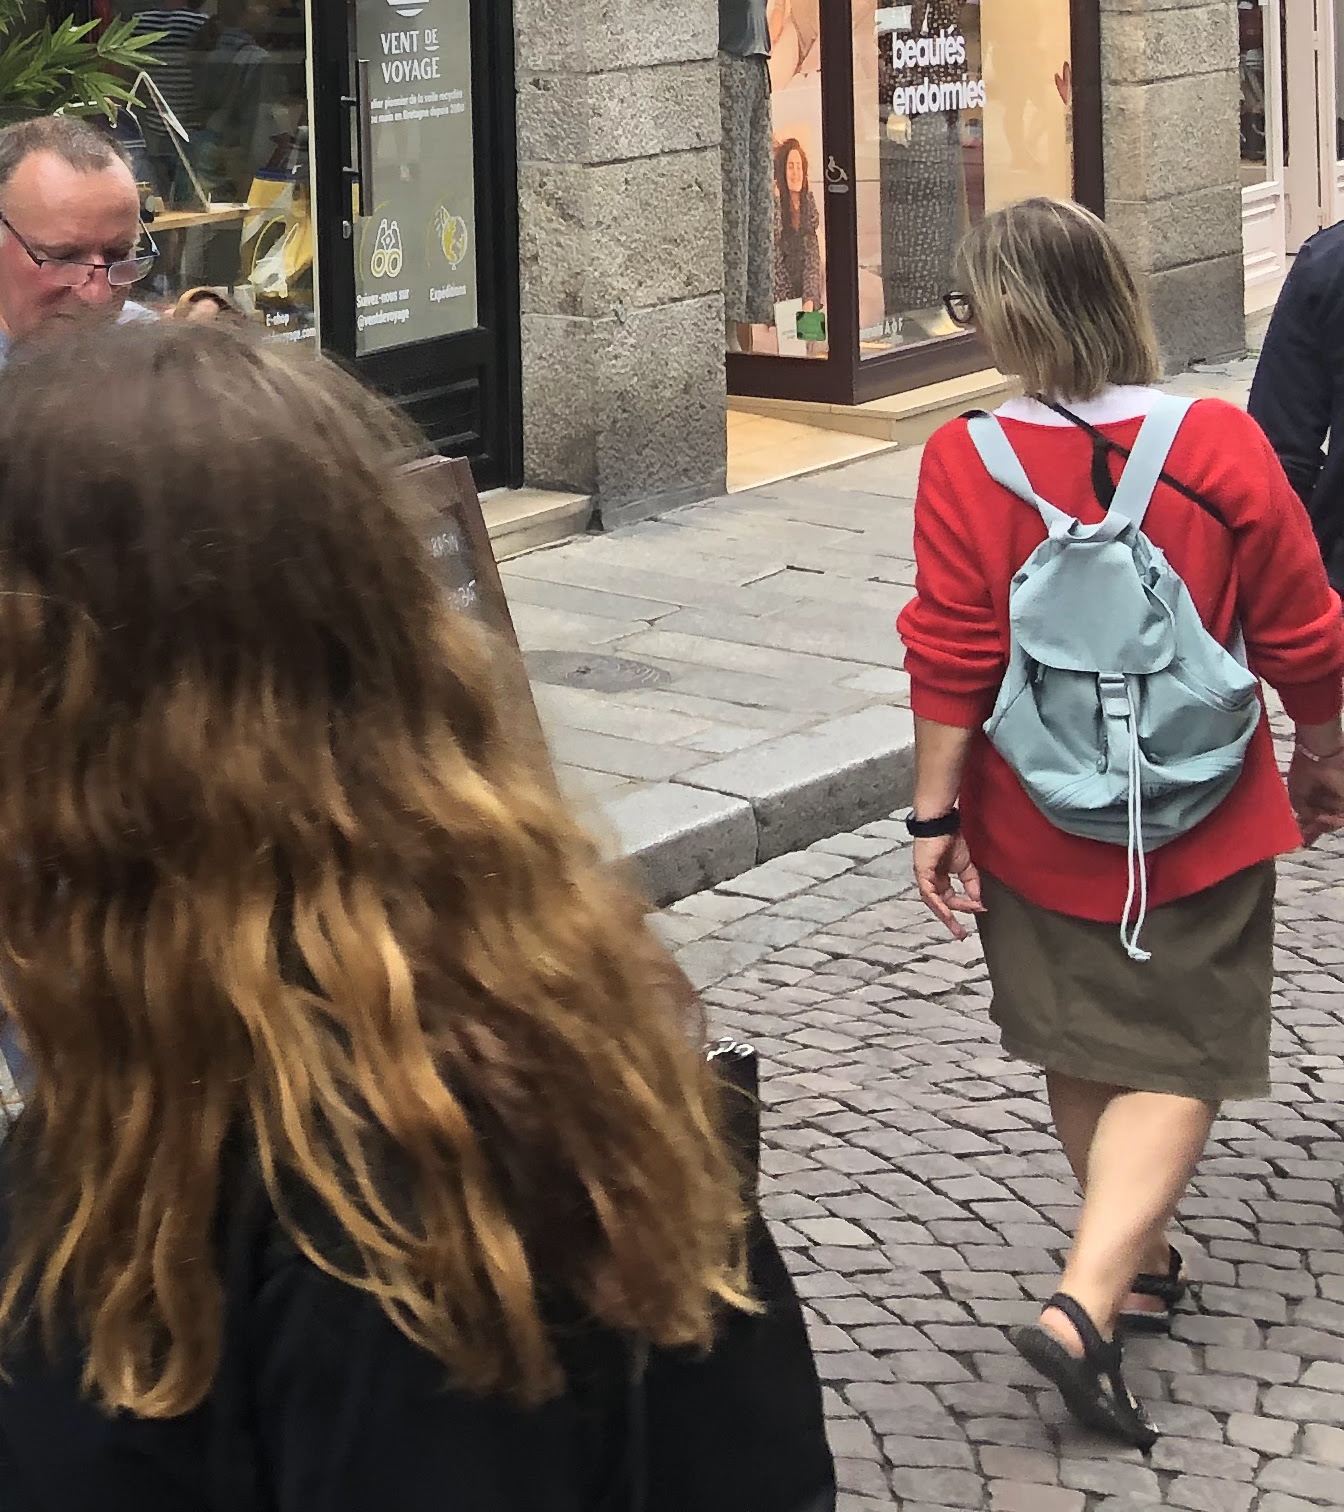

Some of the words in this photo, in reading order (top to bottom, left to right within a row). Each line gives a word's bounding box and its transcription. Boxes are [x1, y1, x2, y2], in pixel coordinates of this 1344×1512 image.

[380, 30, 420, 55] VENT
[424, 28, 439, 45] DE
[892, 23, 966, 69] beautés
[380, 56, 441, 84] VOYAGE
[893, 72, 987, 116] endormies
